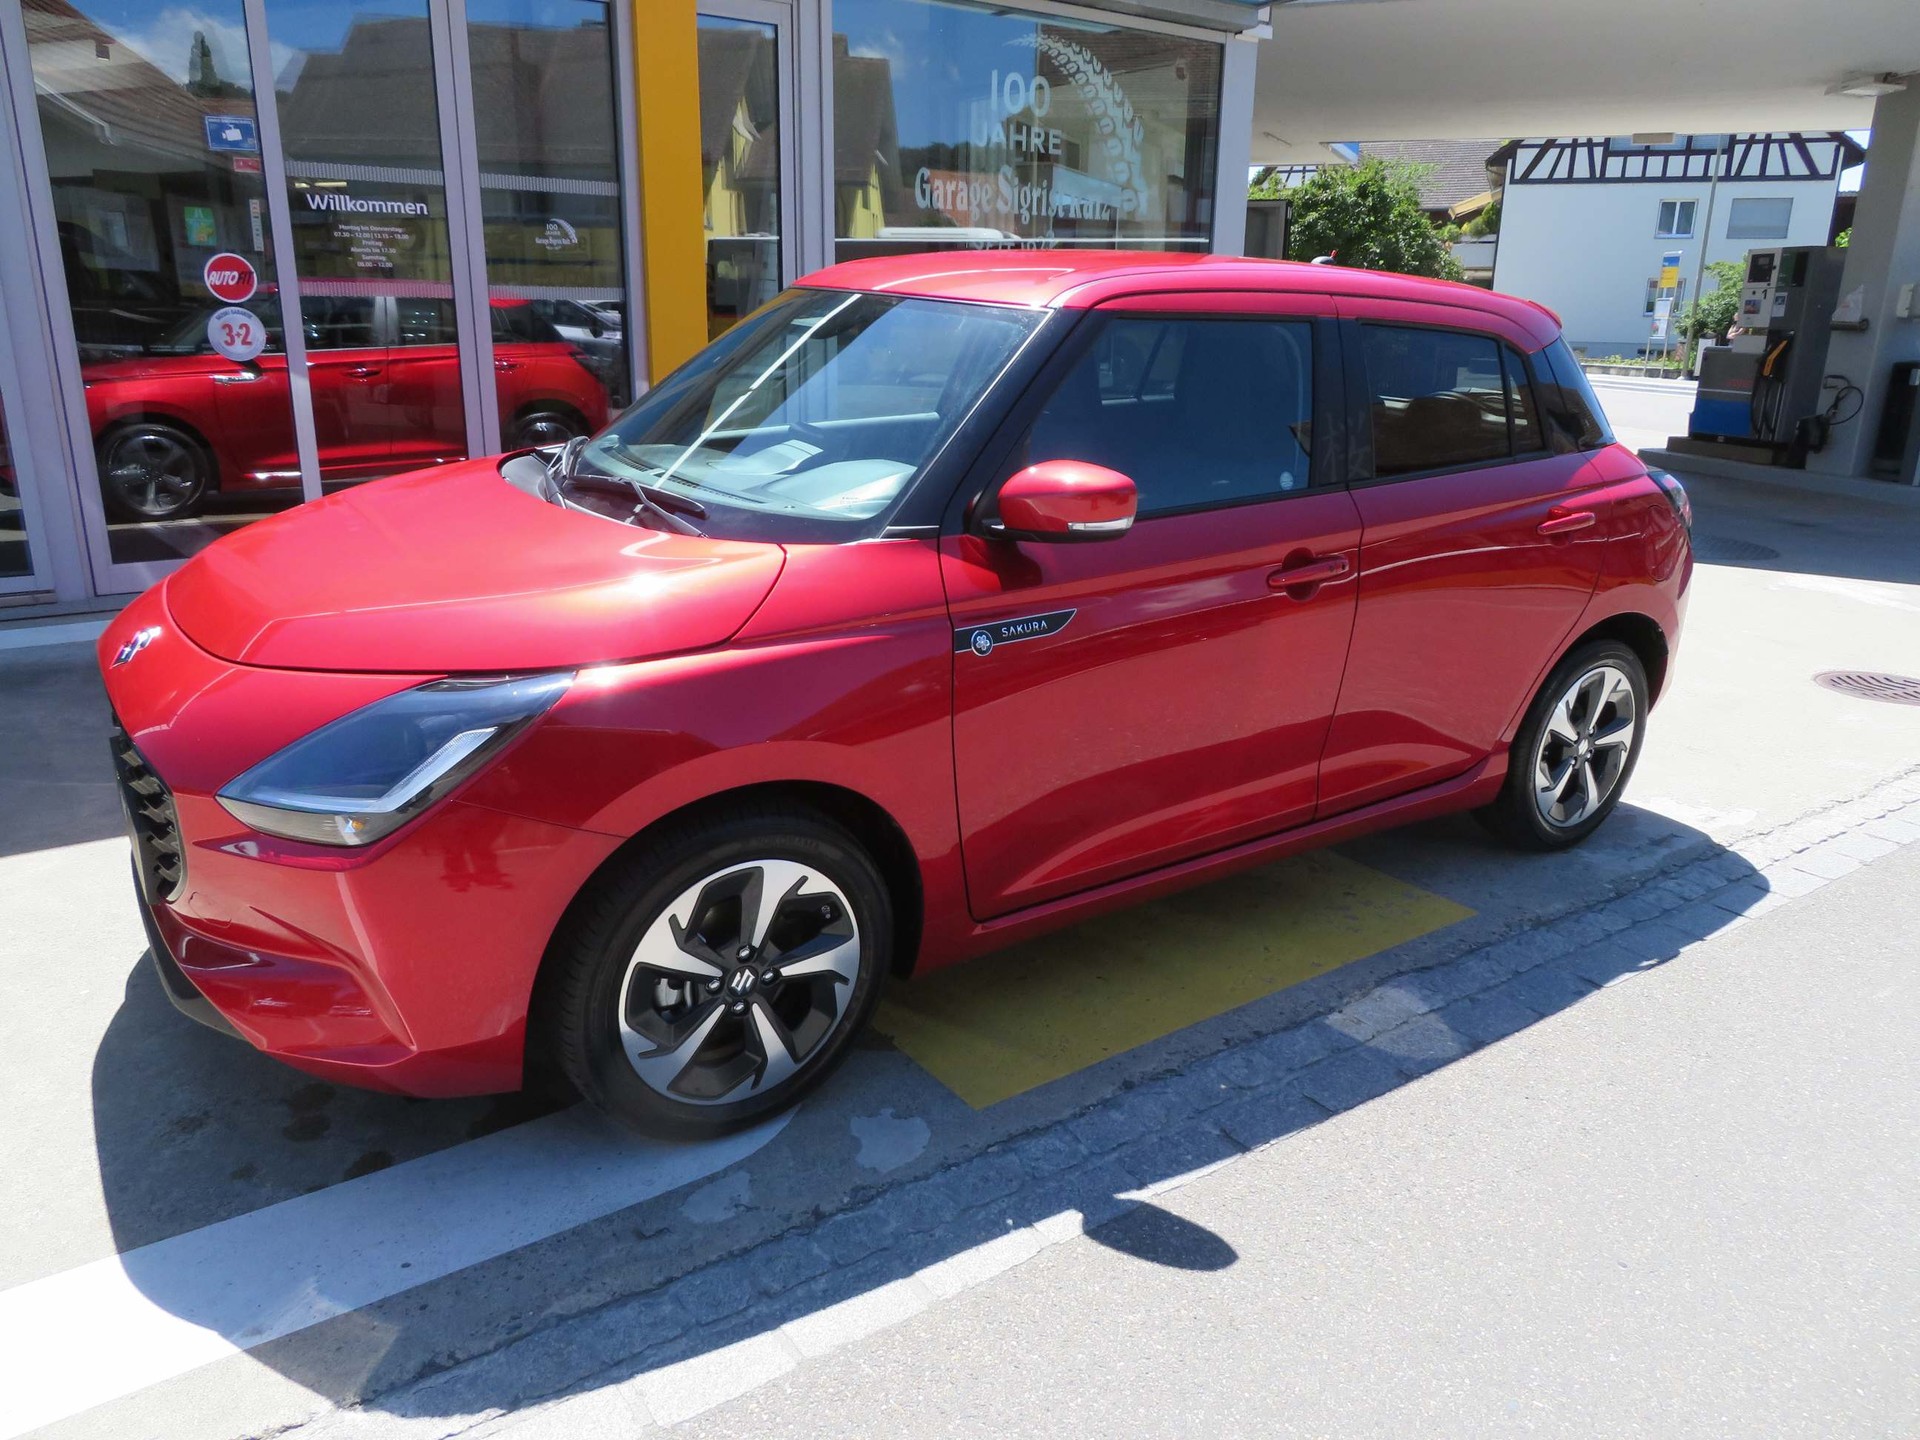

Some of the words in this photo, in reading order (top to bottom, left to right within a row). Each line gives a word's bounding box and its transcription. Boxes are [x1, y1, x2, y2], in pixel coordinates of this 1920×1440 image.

[990, 69, 1050, 117] 100
[970, 120, 1063, 155] JAHRE
[306, 193, 429, 215] Willkommen
[914, 166, 992, 222] Garage
[1001, 620, 1048, 638] SAKURA
